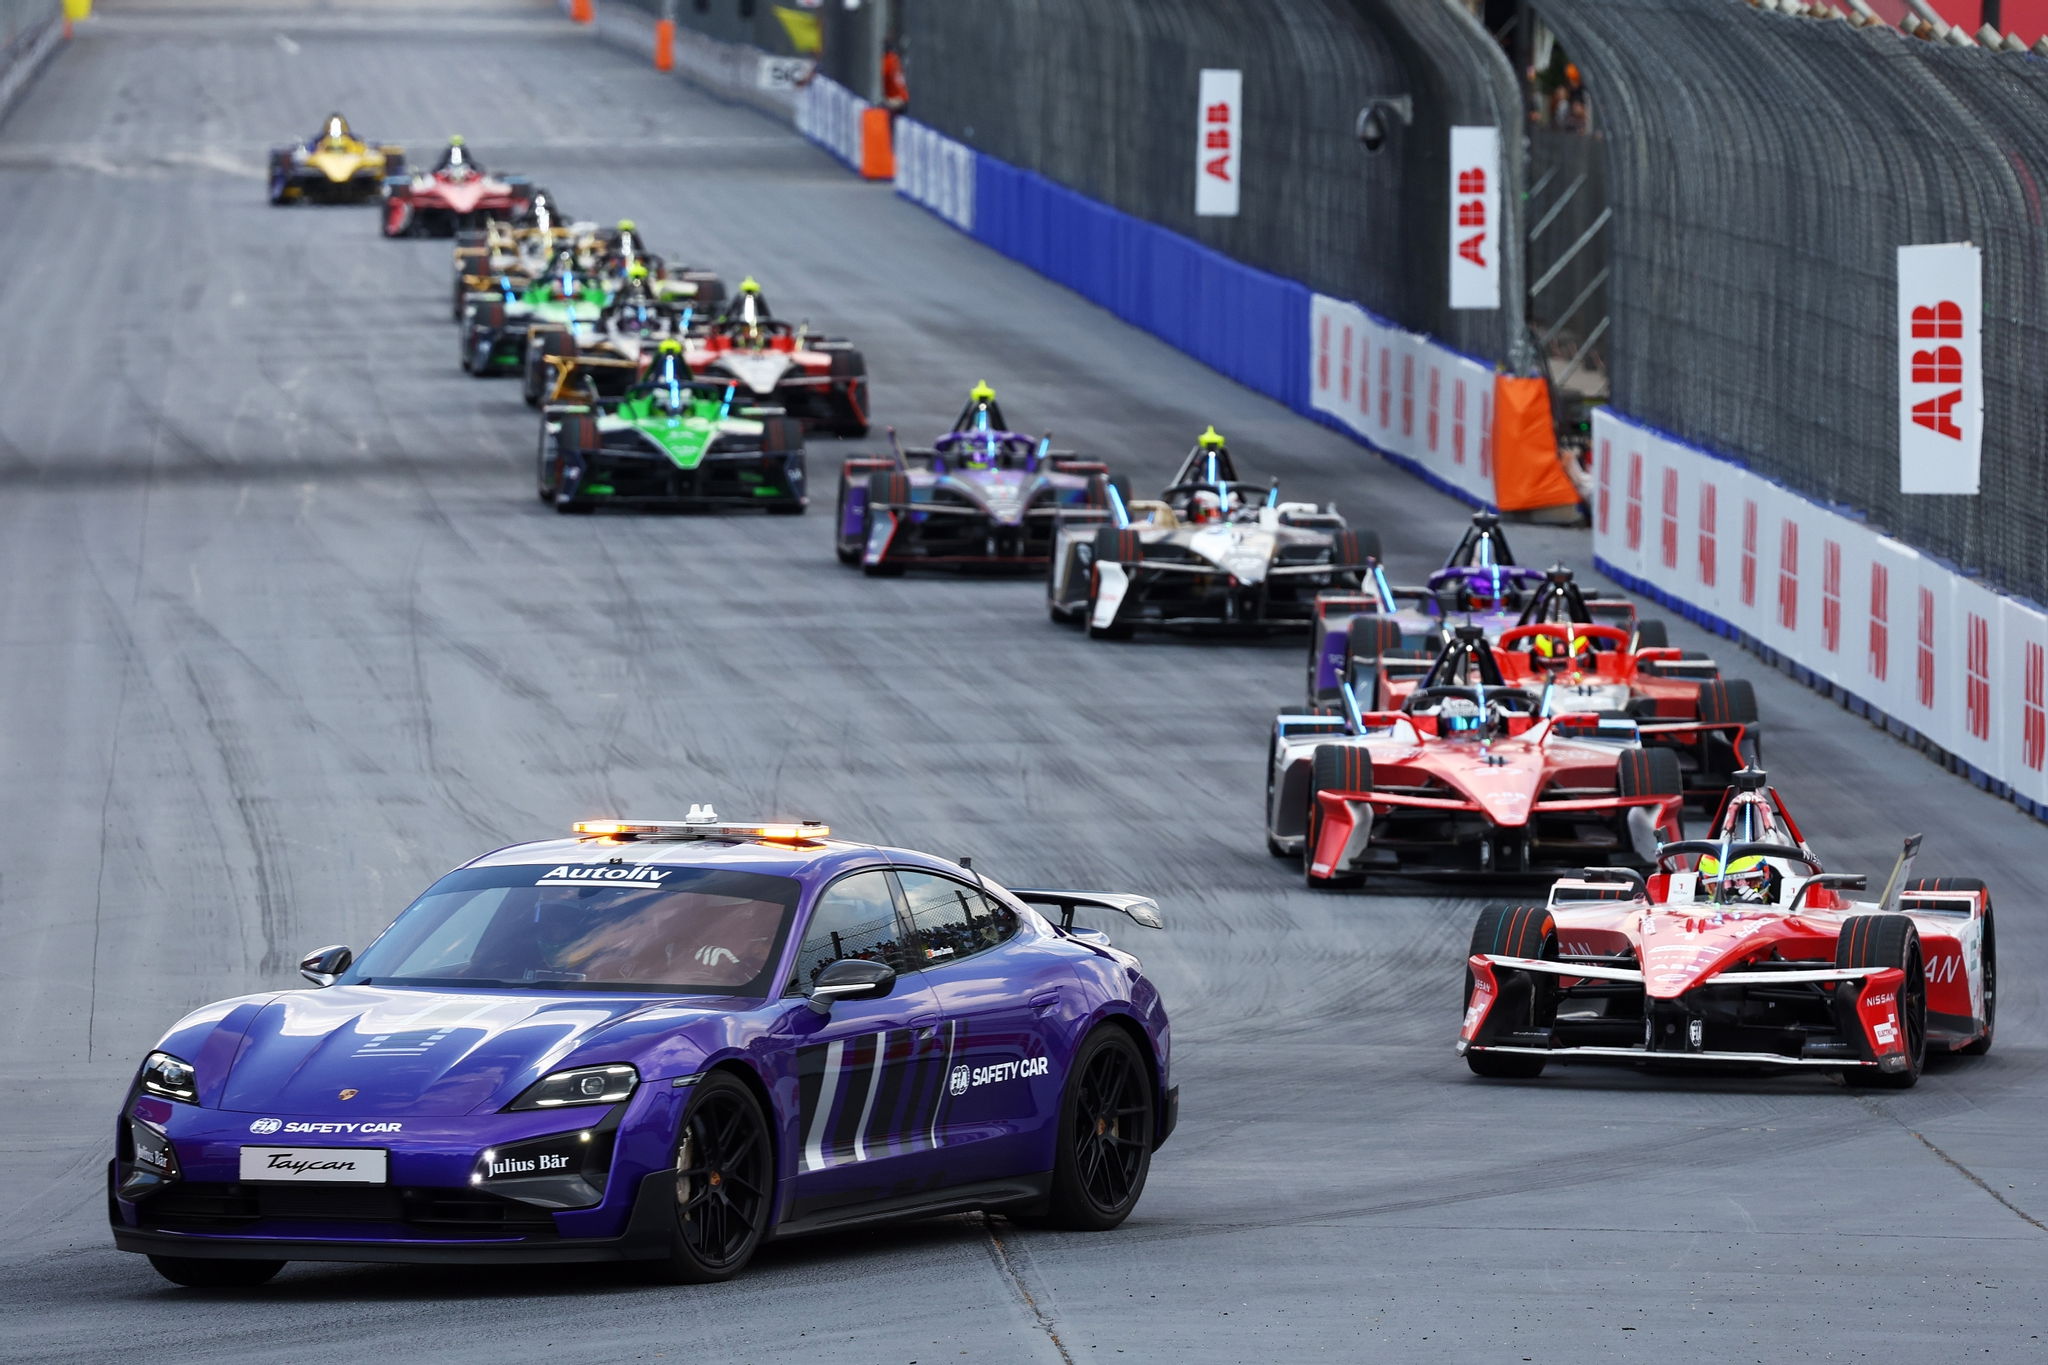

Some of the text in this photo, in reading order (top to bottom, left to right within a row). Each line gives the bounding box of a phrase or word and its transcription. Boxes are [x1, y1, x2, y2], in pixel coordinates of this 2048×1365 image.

[1205, 102, 1230, 182] ABB
[1458, 167, 1487, 268] ABB
[1911, 299, 1964, 441] ABB
[542, 866, 672, 881] Autoliv
[950, 1057, 1048, 1092] FIA SAFETY CAR
[250, 1119, 403, 1133] FIA SAFETY CAR
[267, 1153, 356, 1175] Taycan
[488, 1154, 569, 1178] Julius Bär
